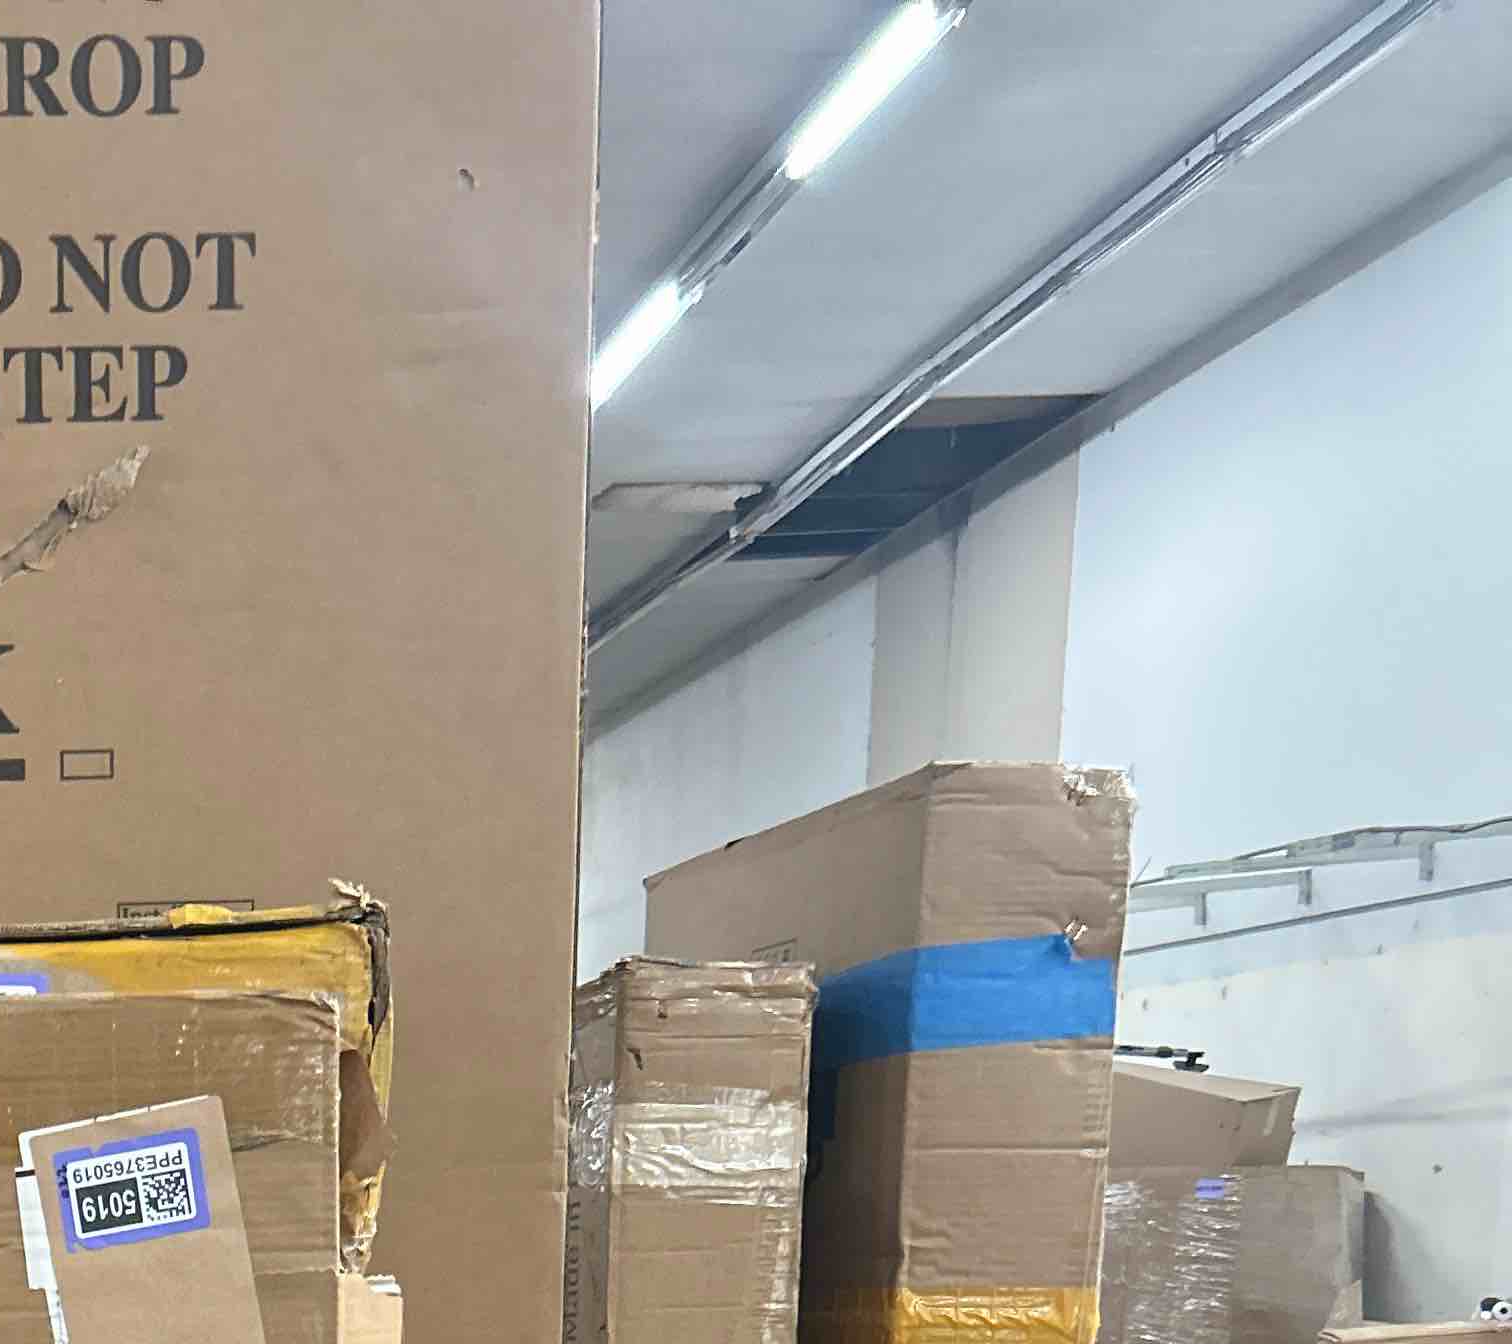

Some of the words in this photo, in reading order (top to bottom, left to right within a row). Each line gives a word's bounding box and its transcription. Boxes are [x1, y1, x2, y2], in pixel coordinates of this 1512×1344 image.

[50, 231, 257, 314] NOT
[73, 1150, 182, 1183] PPE3765019
[82, 1189, 136, 1222] 5019
